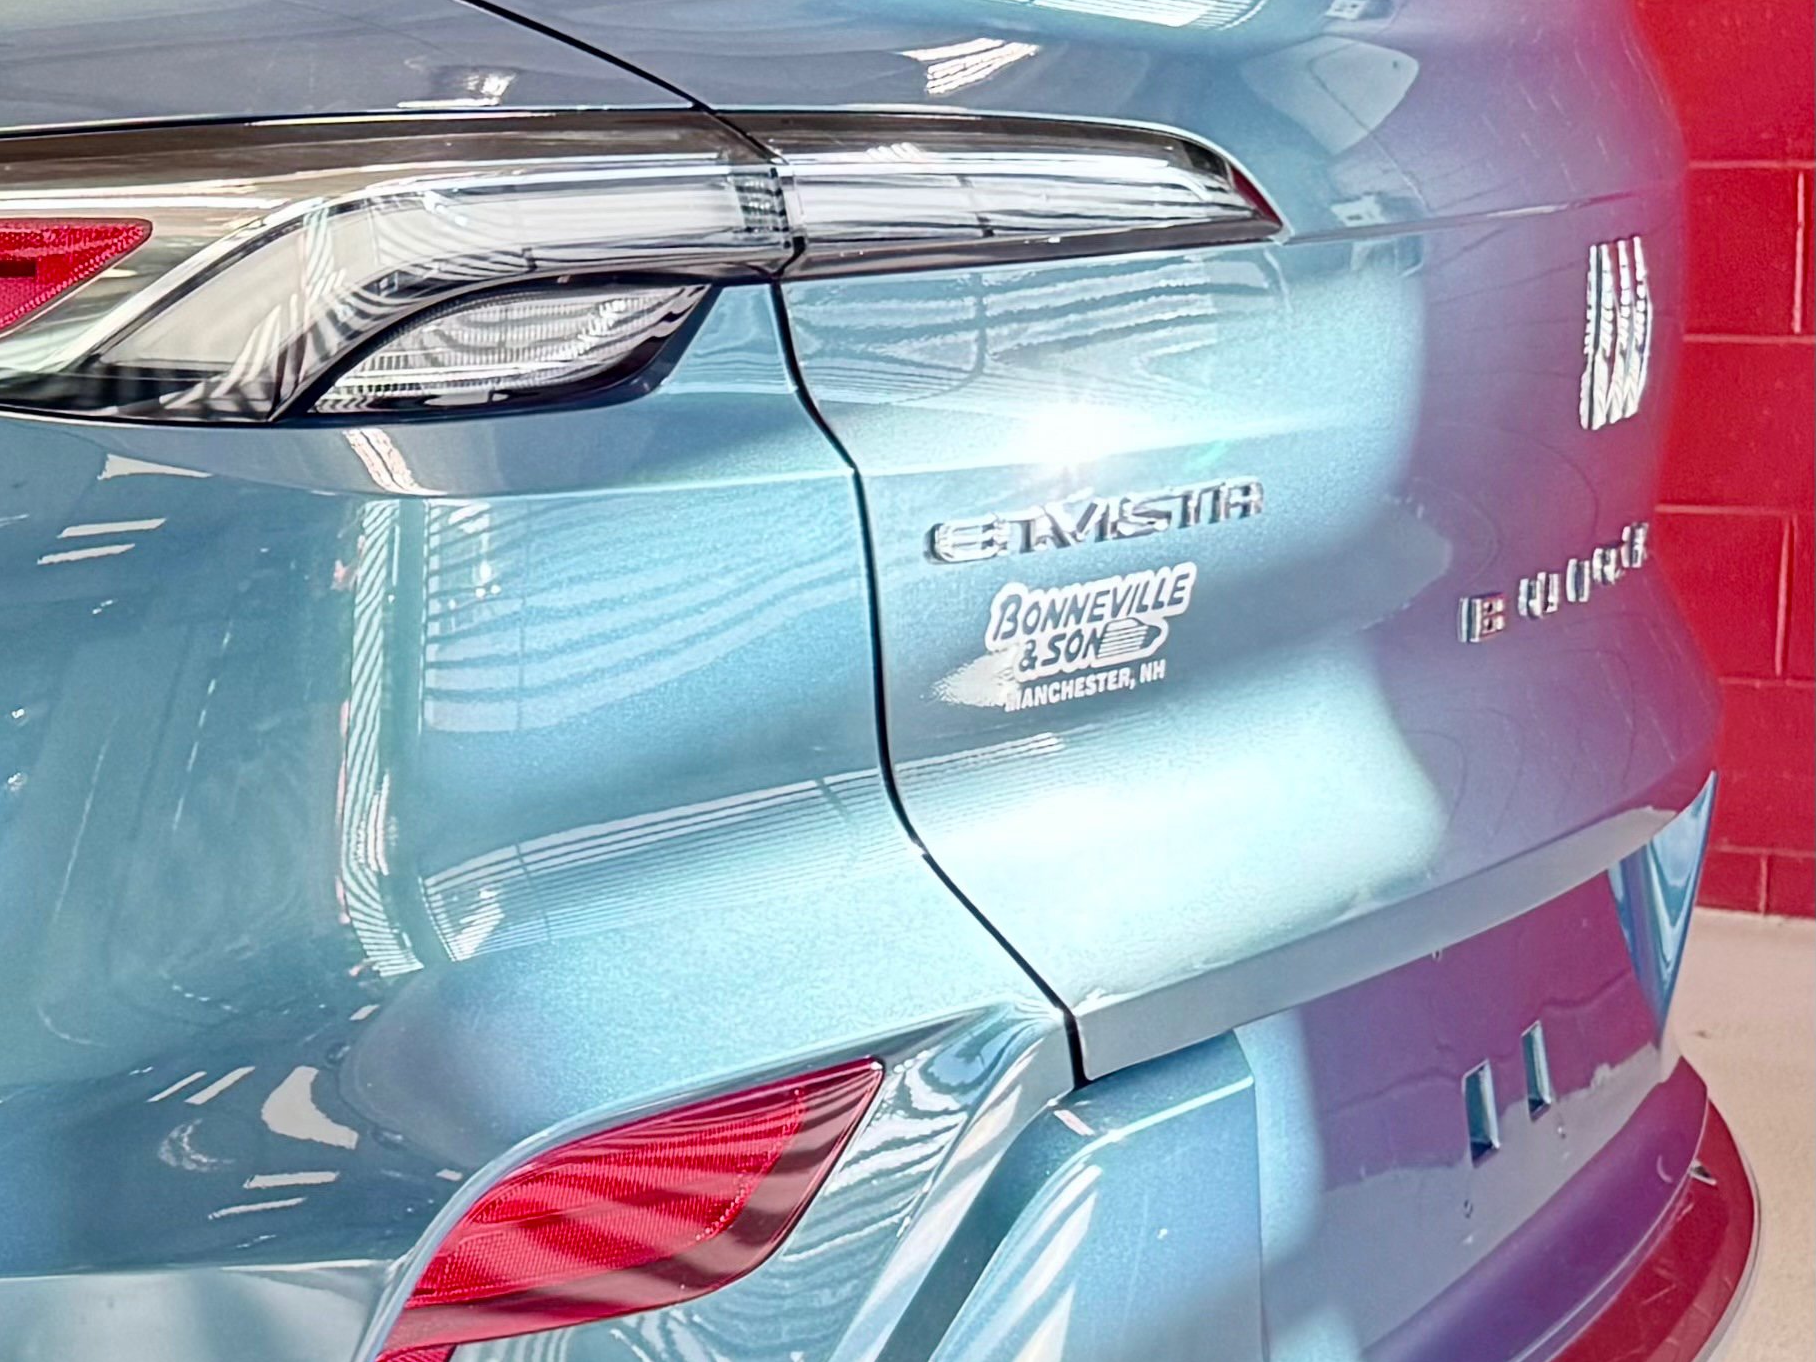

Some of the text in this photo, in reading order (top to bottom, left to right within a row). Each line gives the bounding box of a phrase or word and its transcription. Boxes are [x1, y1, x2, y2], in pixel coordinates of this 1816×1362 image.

[993, 572, 1190, 642] BONNEVILLE
[1018, 626, 1107, 673] & SON
[1139, 659, 1167, 684] NH
